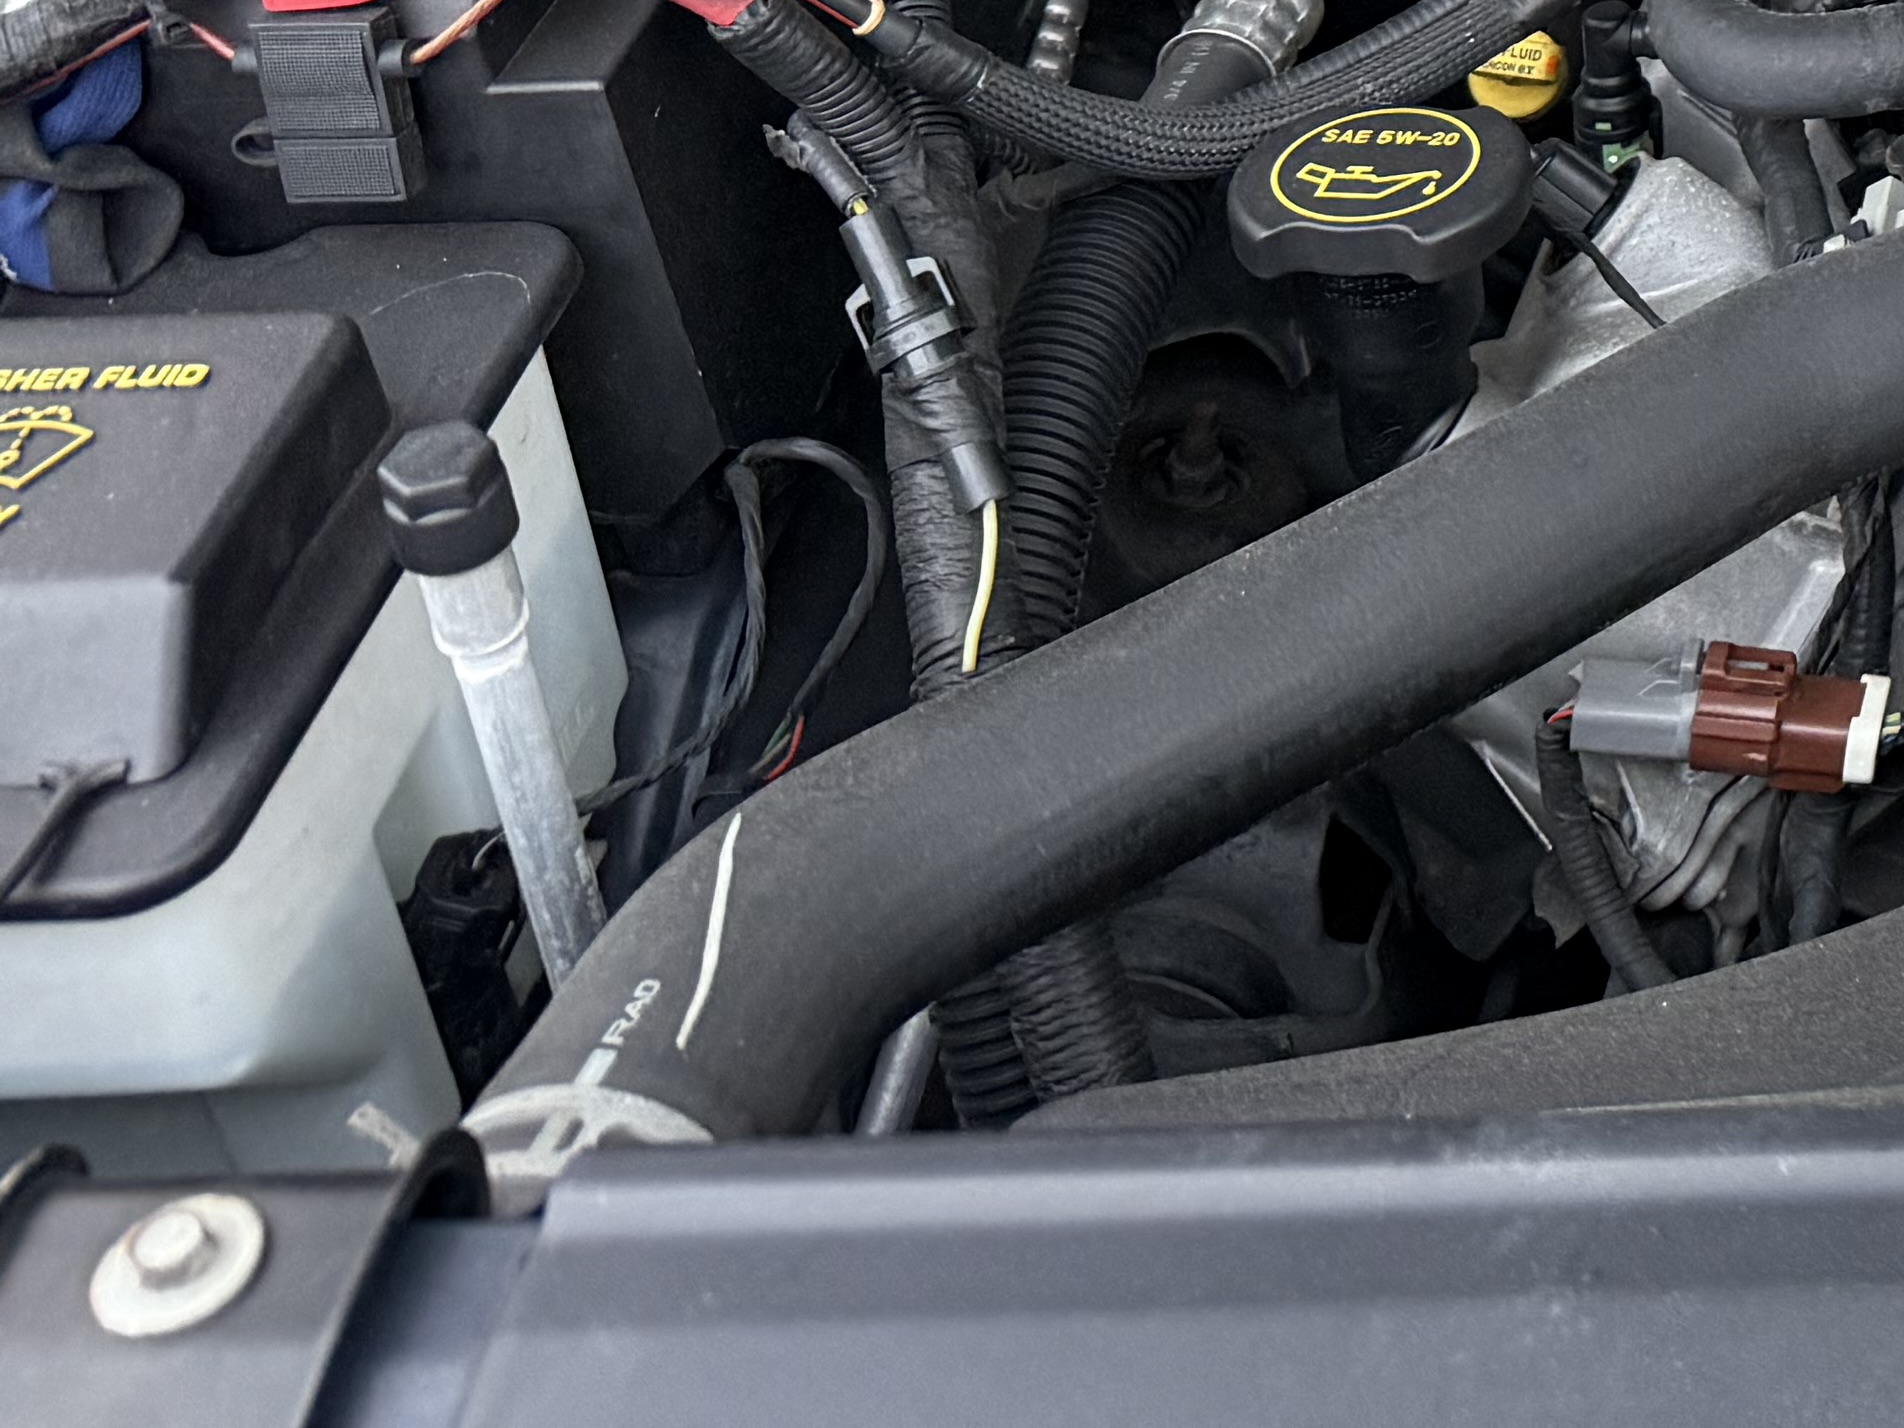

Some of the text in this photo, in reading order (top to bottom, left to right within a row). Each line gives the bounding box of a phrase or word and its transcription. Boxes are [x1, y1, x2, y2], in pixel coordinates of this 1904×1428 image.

[1322, 128, 1461, 146] SAE 5W-20
[93, 363, 210, 389] FLUID
[601, 978, 661, 1046] RAD
